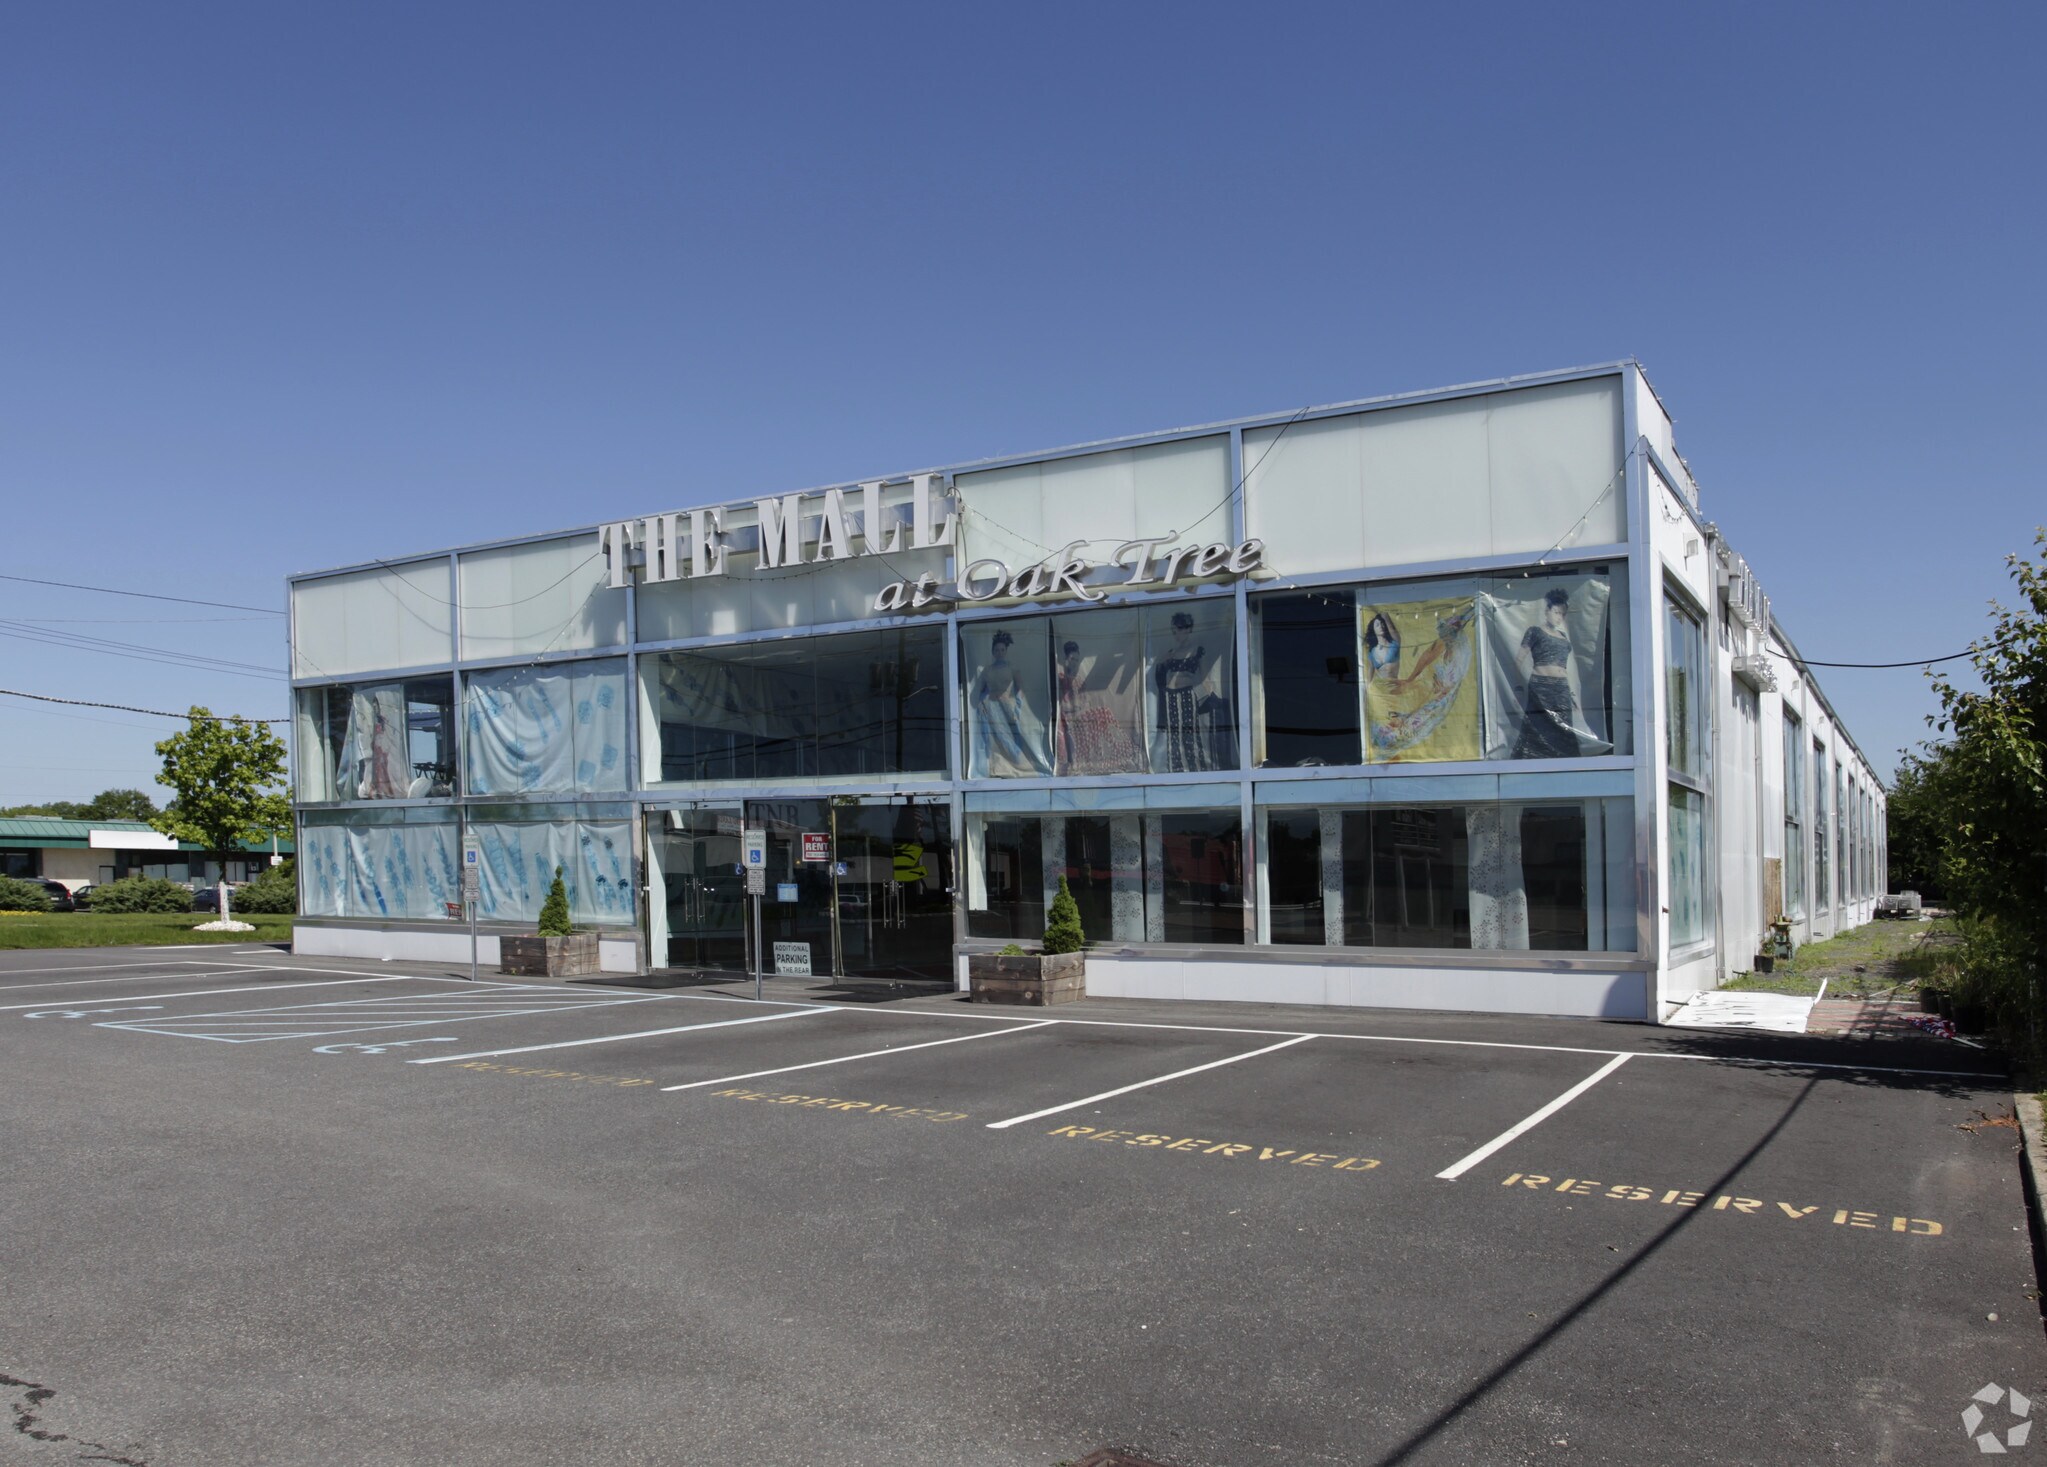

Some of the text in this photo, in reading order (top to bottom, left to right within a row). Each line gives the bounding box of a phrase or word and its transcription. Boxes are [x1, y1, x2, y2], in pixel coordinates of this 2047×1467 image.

[599, 471, 957, 589] THE MALL
[874, 530, 1265, 611] at Oak Tree
[805, 842, 828, 851] RENT
[776, 954, 808, 964] PARKING
[711, 1089, 969, 1122] RESERVED
[1048, 1125, 1381, 1171] RESERVED
[1501, 1173, 1943, 1236] RESERVED
